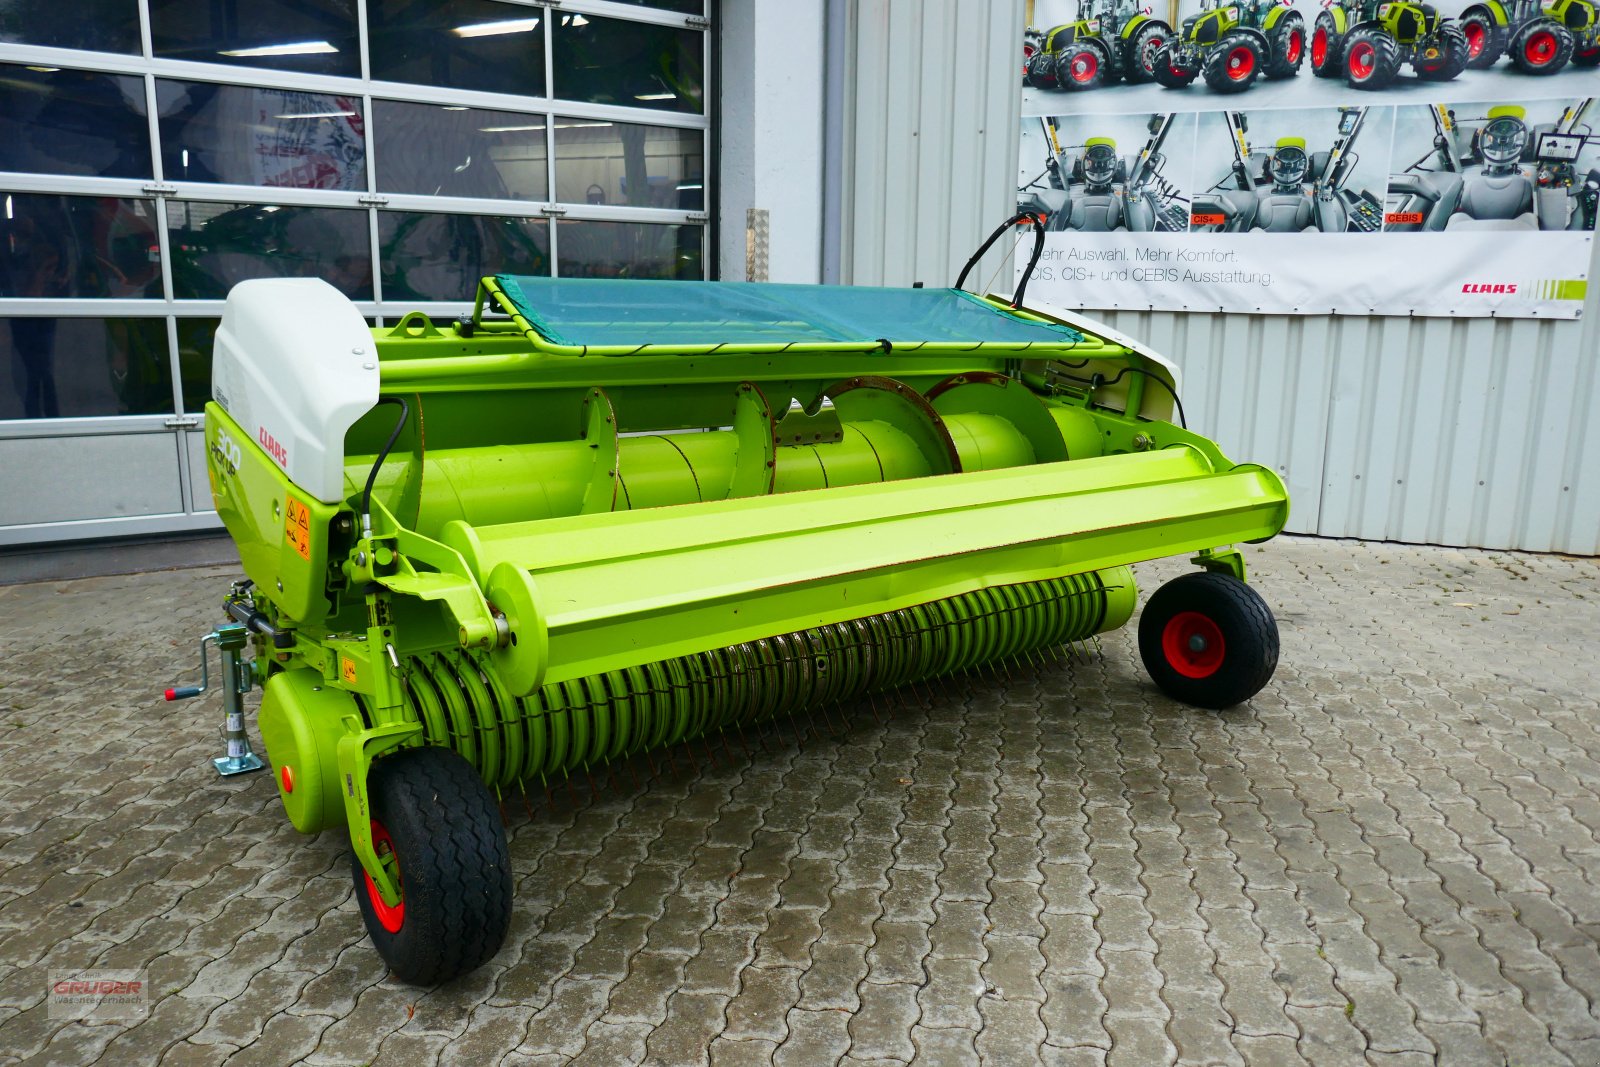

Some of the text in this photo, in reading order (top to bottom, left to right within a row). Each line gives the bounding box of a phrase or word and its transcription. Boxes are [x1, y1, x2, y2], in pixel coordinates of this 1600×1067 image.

[1193, 215, 1214, 223] CIS+
[1388, 213, 1419, 222] CEBIS
[1067, 247, 1129, 261] Auswahl.
[1135, 247, 1172, 261] Mehr
[1176, 248, 1238, 263] Komfort.
[1029, 266, 1275, 287] CIS, CIS+ und CEBIS Ausstattung.
[1461, 283, 1518, 294] CLAAS
[218, 426, 242, 471] 300
[260, 426, 287, 468] CLAAS
